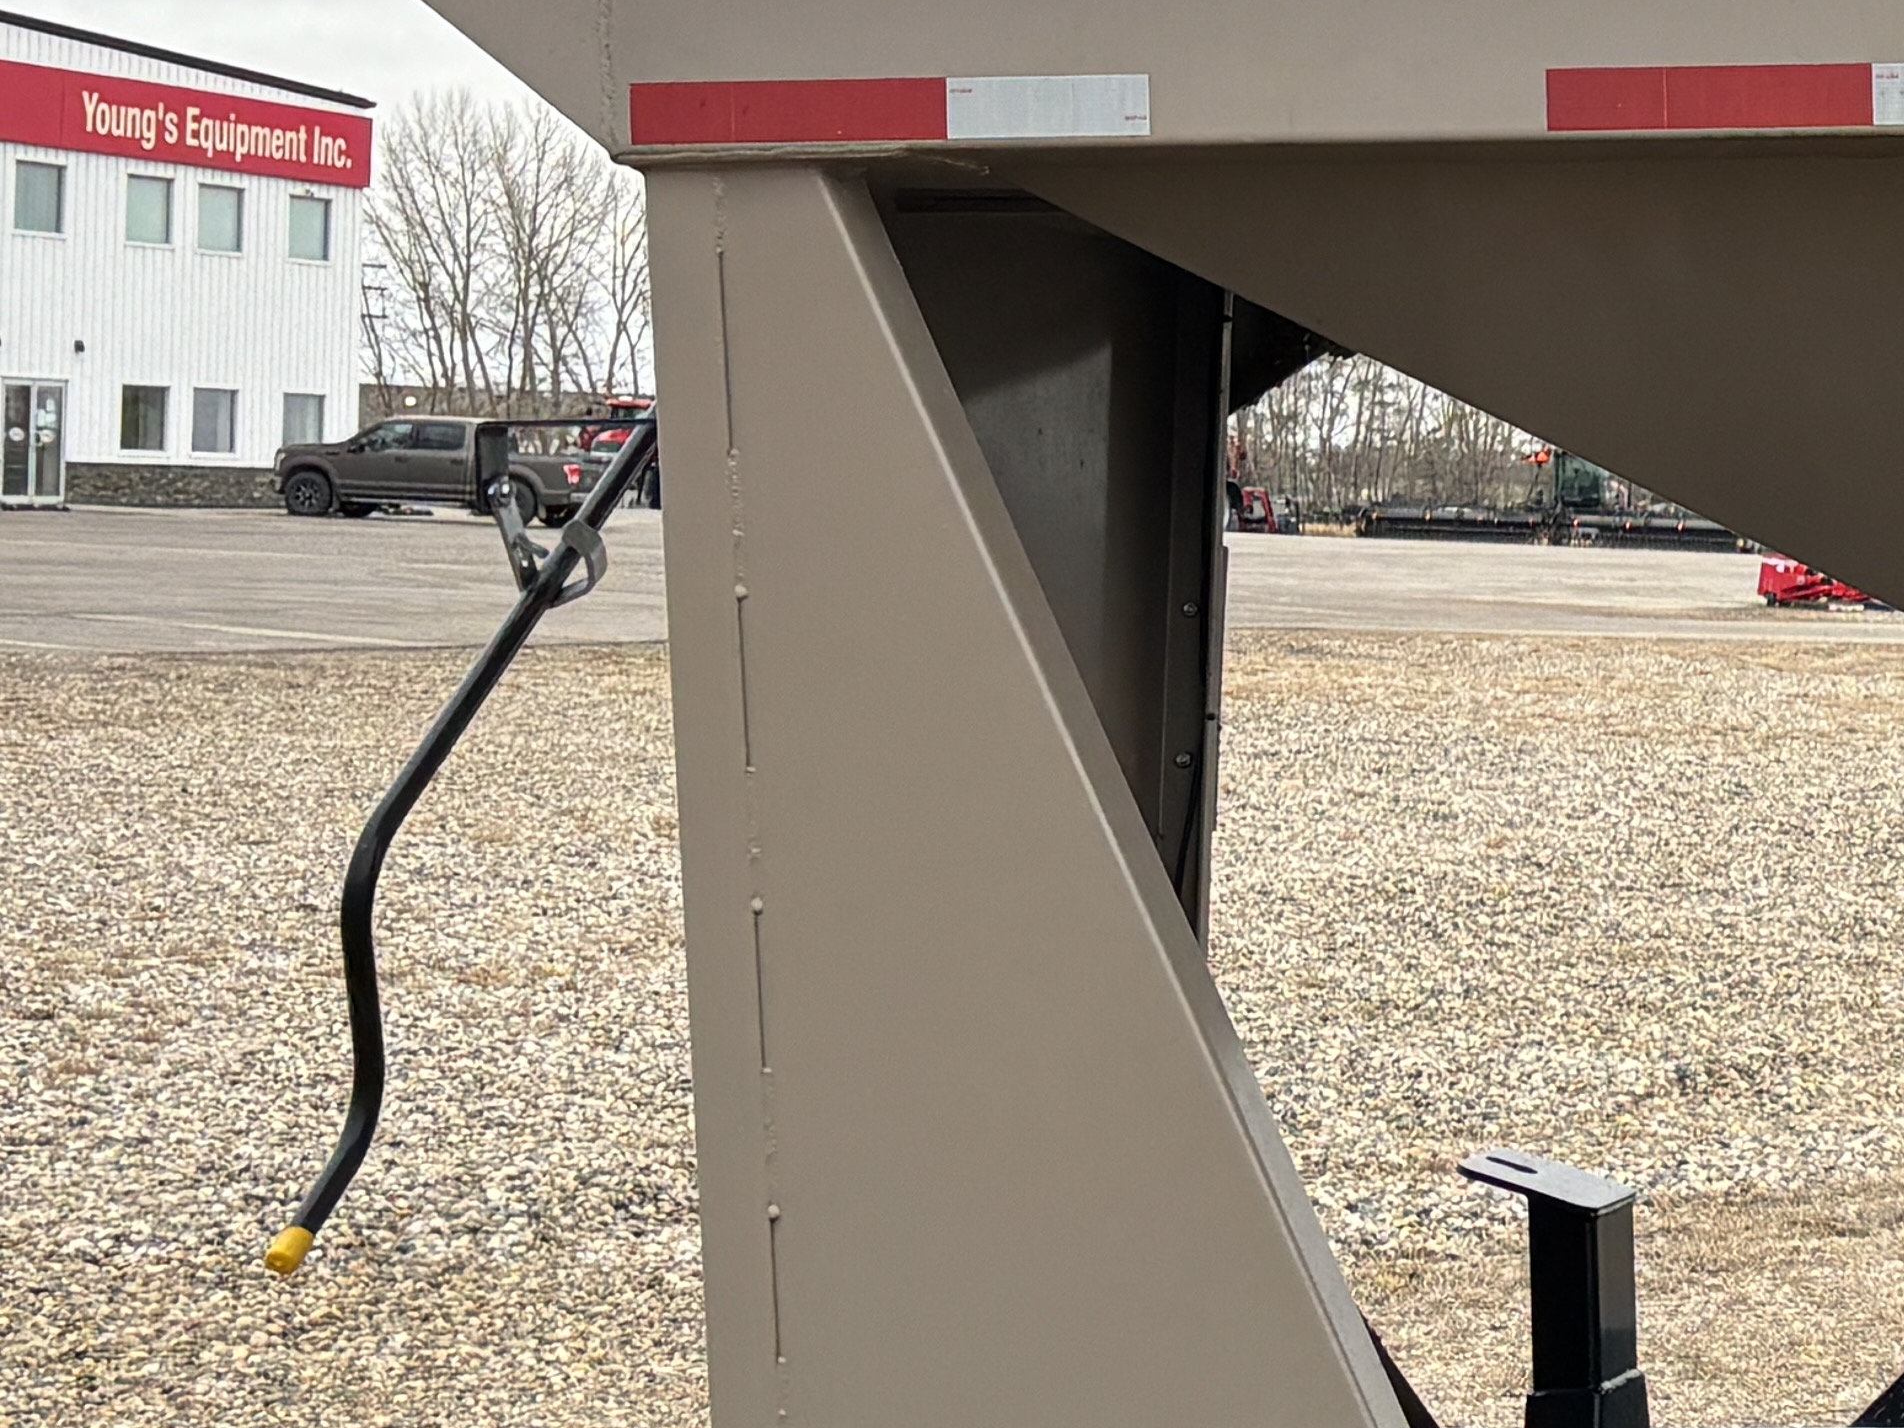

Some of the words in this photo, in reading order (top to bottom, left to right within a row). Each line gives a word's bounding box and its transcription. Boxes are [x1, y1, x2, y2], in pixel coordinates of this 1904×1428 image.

[81, 90, 179, 151] Young's
[185, 105, 308, 163] Equipment
[312, 125, 353, 170] Inc.
